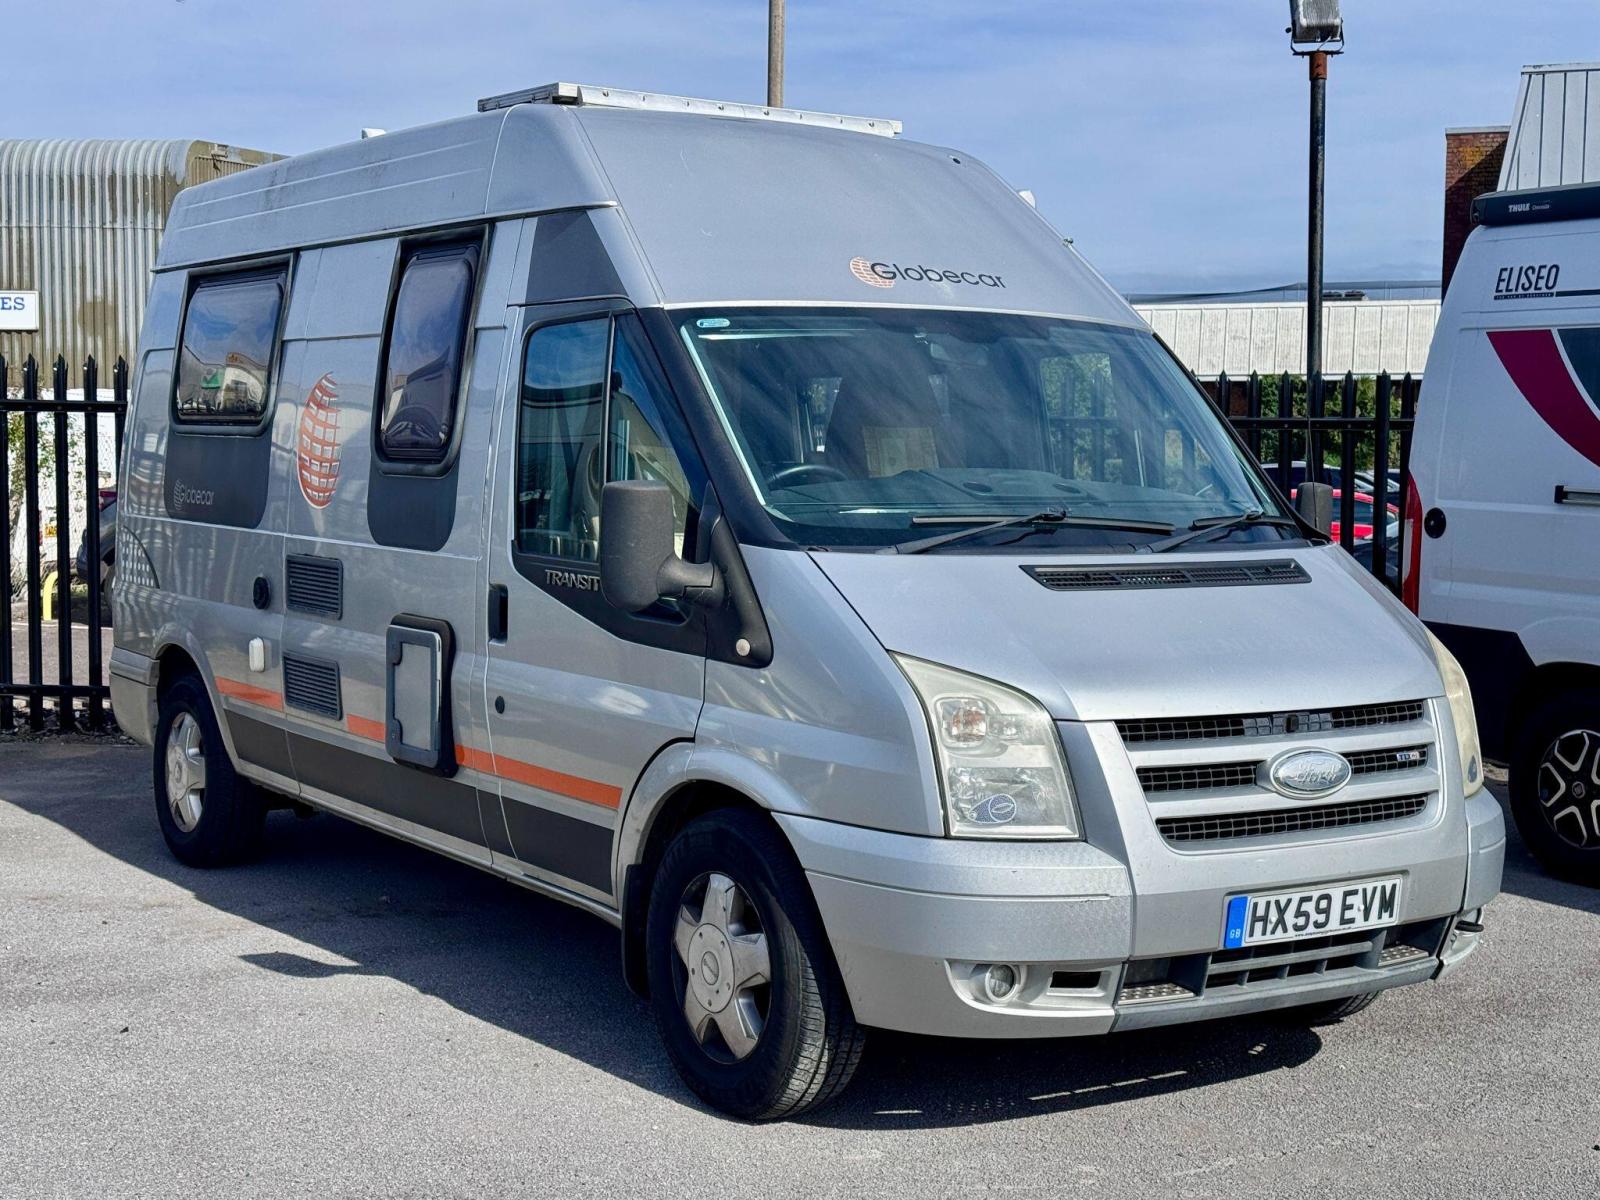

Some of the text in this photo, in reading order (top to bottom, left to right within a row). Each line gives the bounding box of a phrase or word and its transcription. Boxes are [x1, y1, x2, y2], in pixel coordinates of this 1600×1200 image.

[1508, 203, 1530, 213] THULE
[870, 262, 1007, 289] Globecar
[1495, 264, 1560, 293] ELISEO
[180, 484, 215, 505] Globecar
[545, 569, 601, 592] TRANSIT
[1248, 883, 1397, 938] HX59 EVM
[1229, 928, 1241, 939] GB
